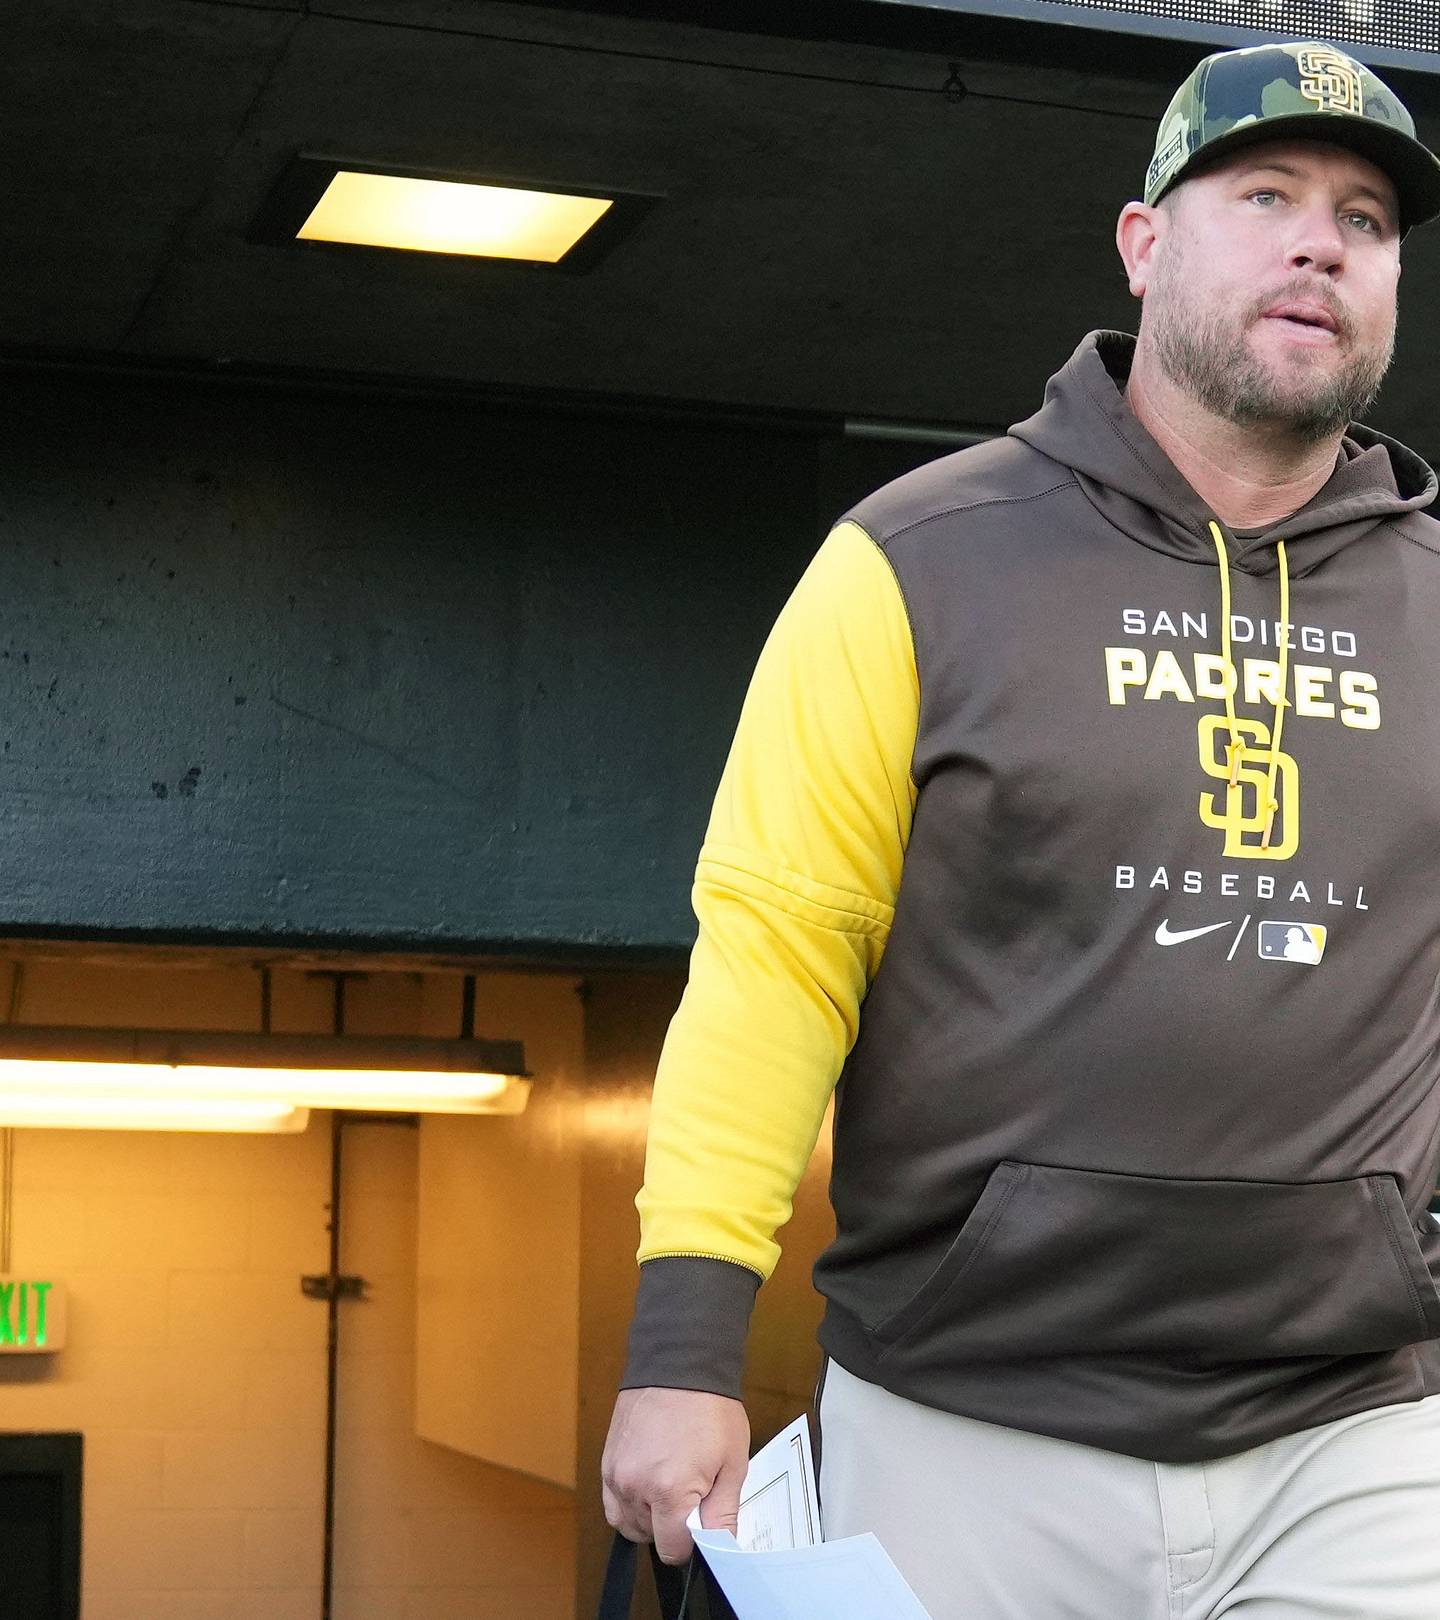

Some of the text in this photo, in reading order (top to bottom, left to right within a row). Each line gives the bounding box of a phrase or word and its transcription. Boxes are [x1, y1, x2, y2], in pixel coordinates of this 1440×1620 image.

[1122, 609, 1357, 657] SAN DIEGO
[1104, 647, 1381, 730] PADRES
[1114, 865, 1370, 911] BASEBALL
[0, 1281, 53, 1346] XIT
